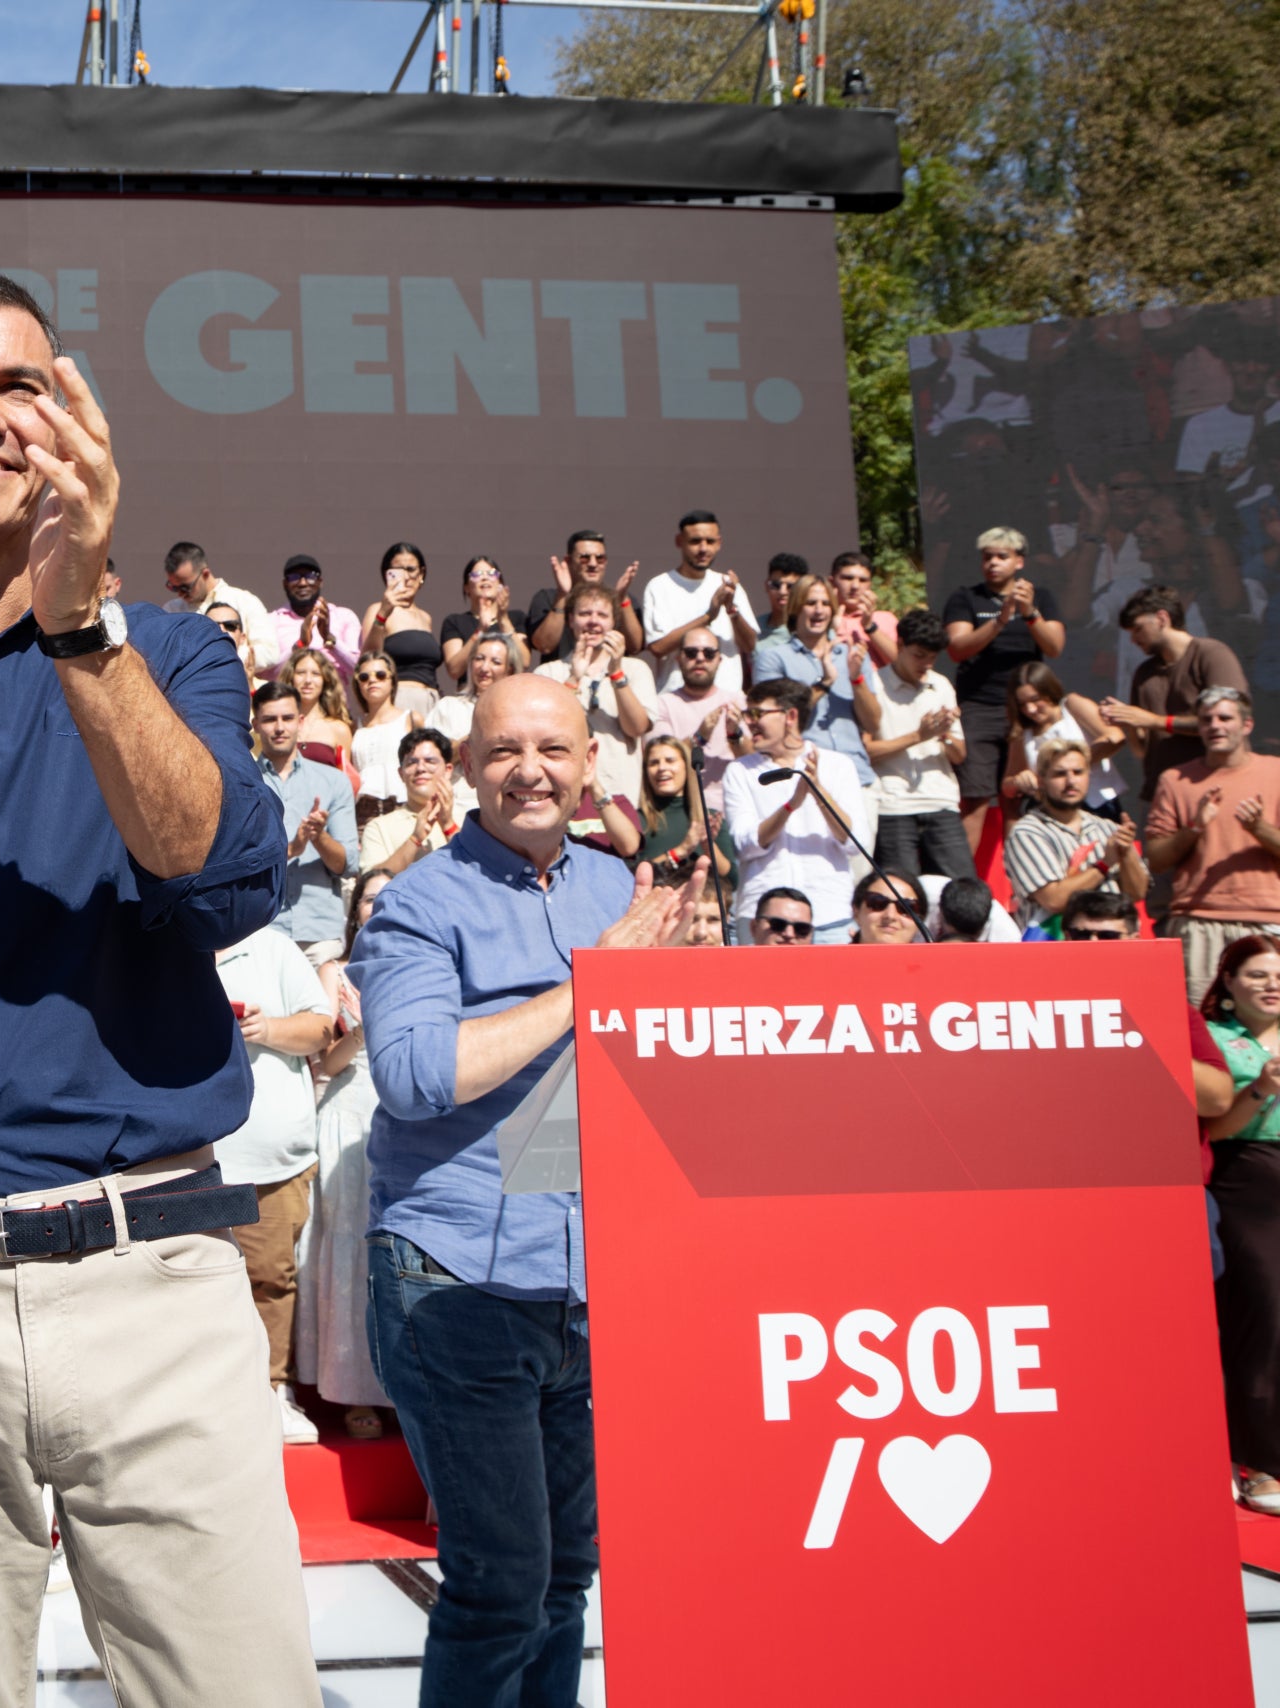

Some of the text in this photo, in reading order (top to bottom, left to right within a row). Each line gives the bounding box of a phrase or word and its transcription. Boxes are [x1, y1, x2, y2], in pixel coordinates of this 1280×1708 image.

[143, 269, 803, 424] GENTE.
[590, 999, 1143, 1057] LA FUERZA DE GENTE.
[884, 1030, 922, 1053] LA
[758, 1305, 1058, 1421] PSOE
